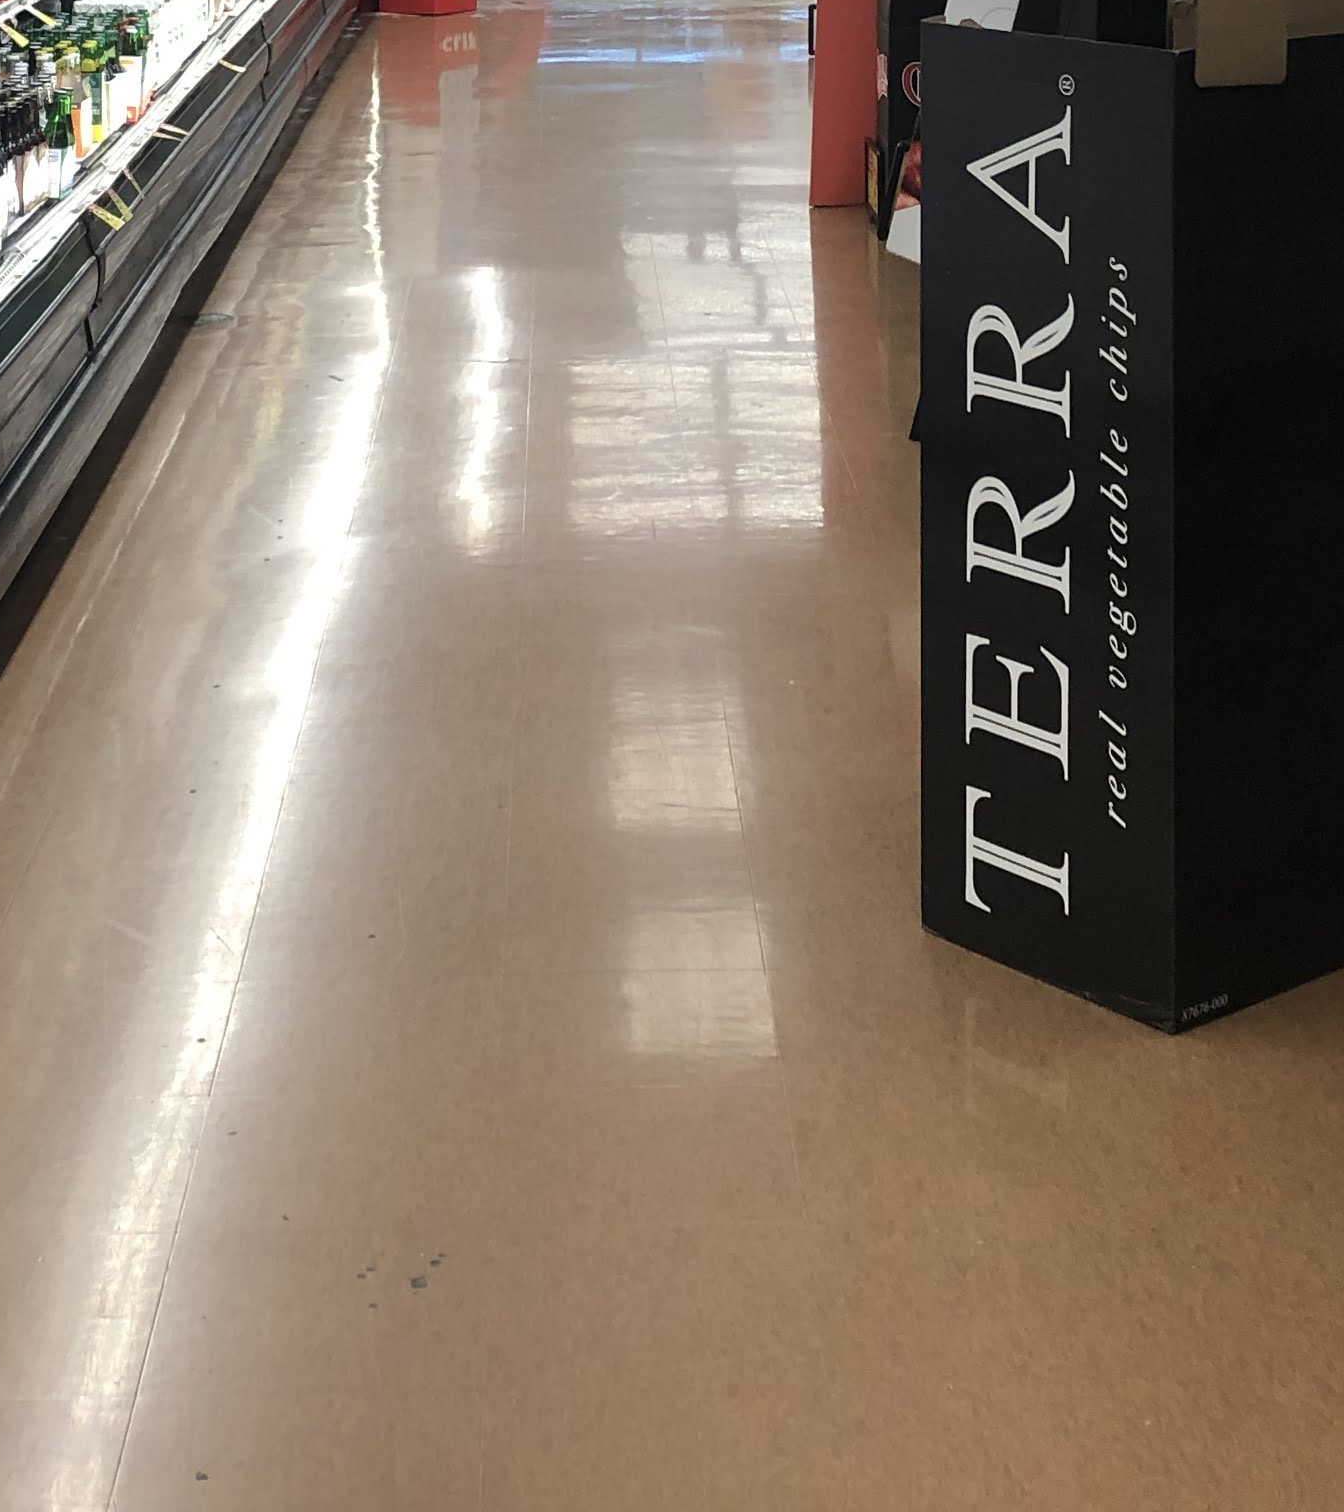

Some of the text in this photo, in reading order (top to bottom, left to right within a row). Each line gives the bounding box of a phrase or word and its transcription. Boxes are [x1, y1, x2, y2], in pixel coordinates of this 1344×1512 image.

[1105, 254, 1138, 829] real vegetable chips
